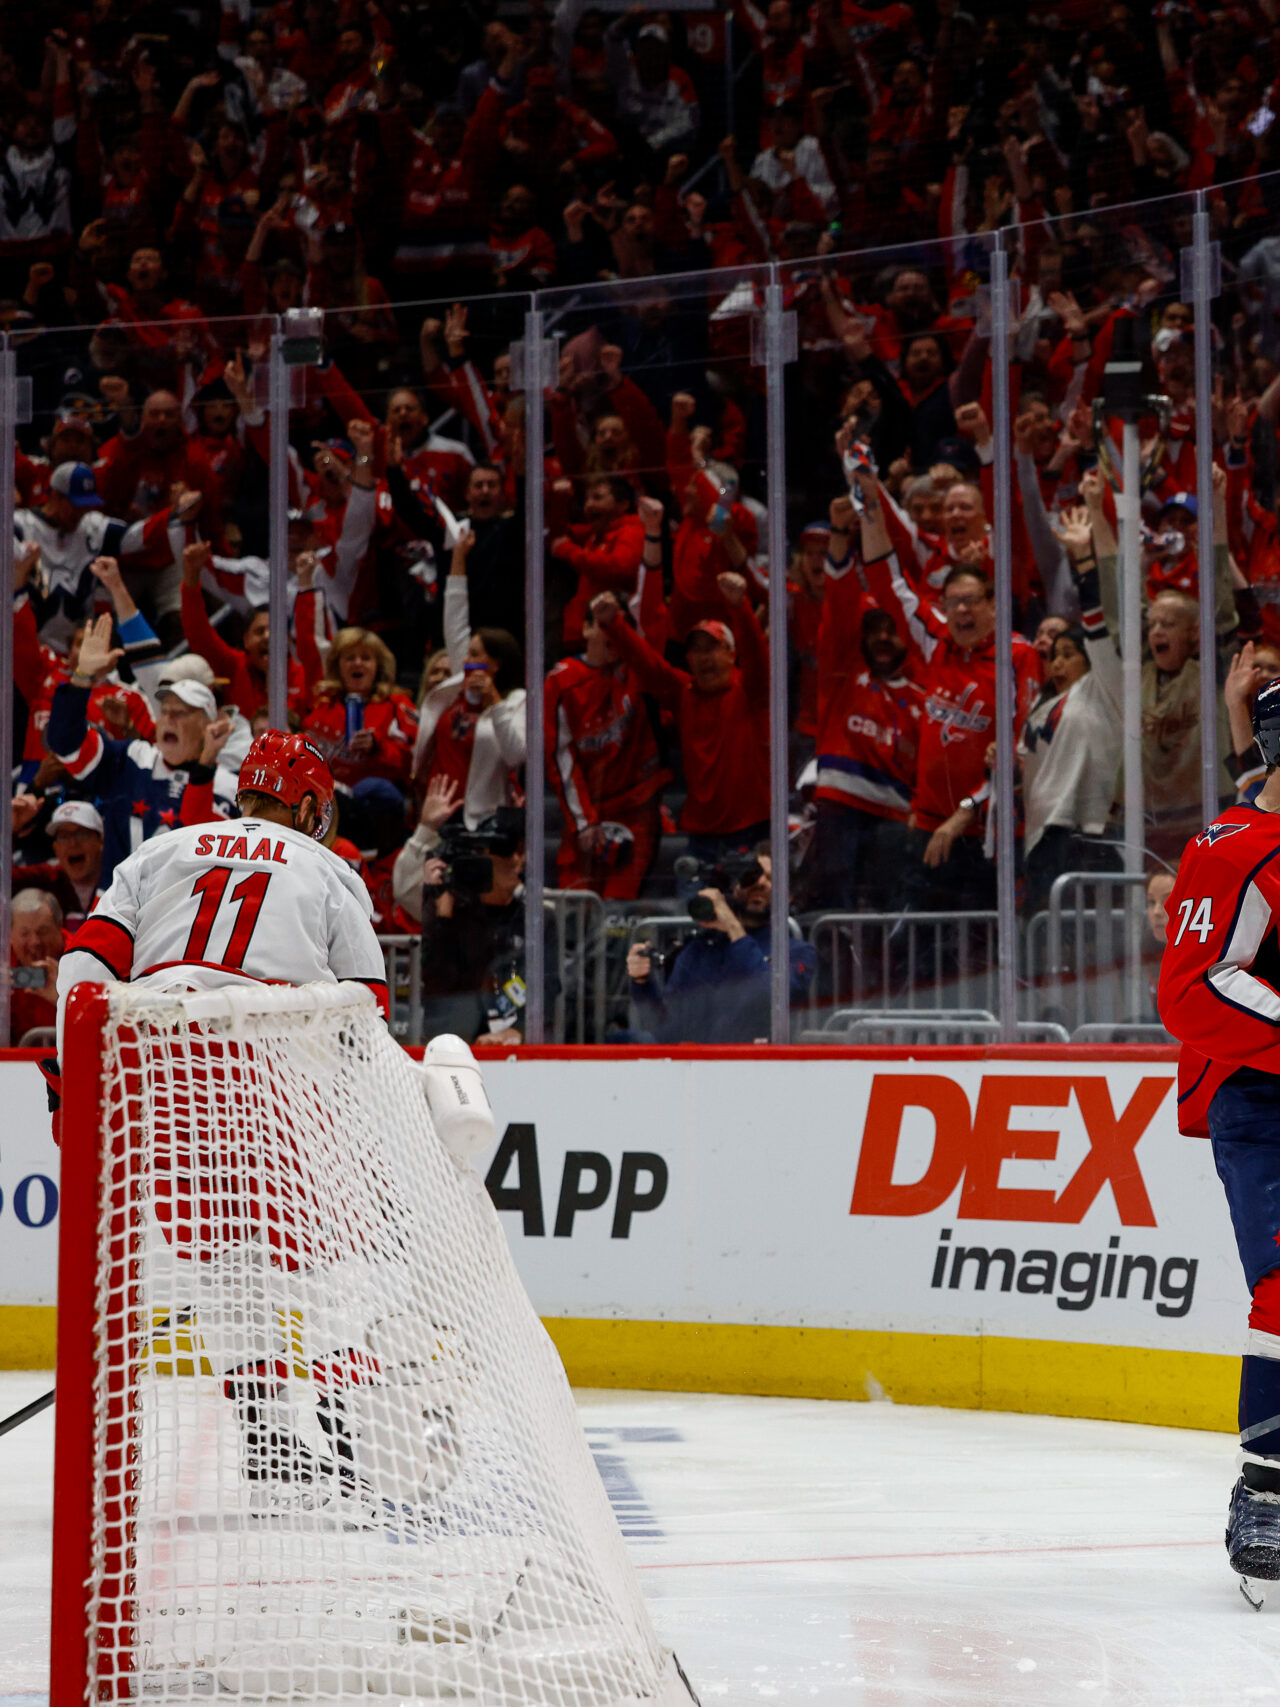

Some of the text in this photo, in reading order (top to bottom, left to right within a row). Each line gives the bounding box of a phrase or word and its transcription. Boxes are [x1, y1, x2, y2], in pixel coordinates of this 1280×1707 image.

[252, 768, 266, 786] 11
[194, 833, 288, 865] STAAL
[182, 865, 273, 970] 11
[1174, 896, 1215, 948] 74
[849, 1073, 1177, 1228] DEX
[931, 1228, 1199, 1318] imaging
